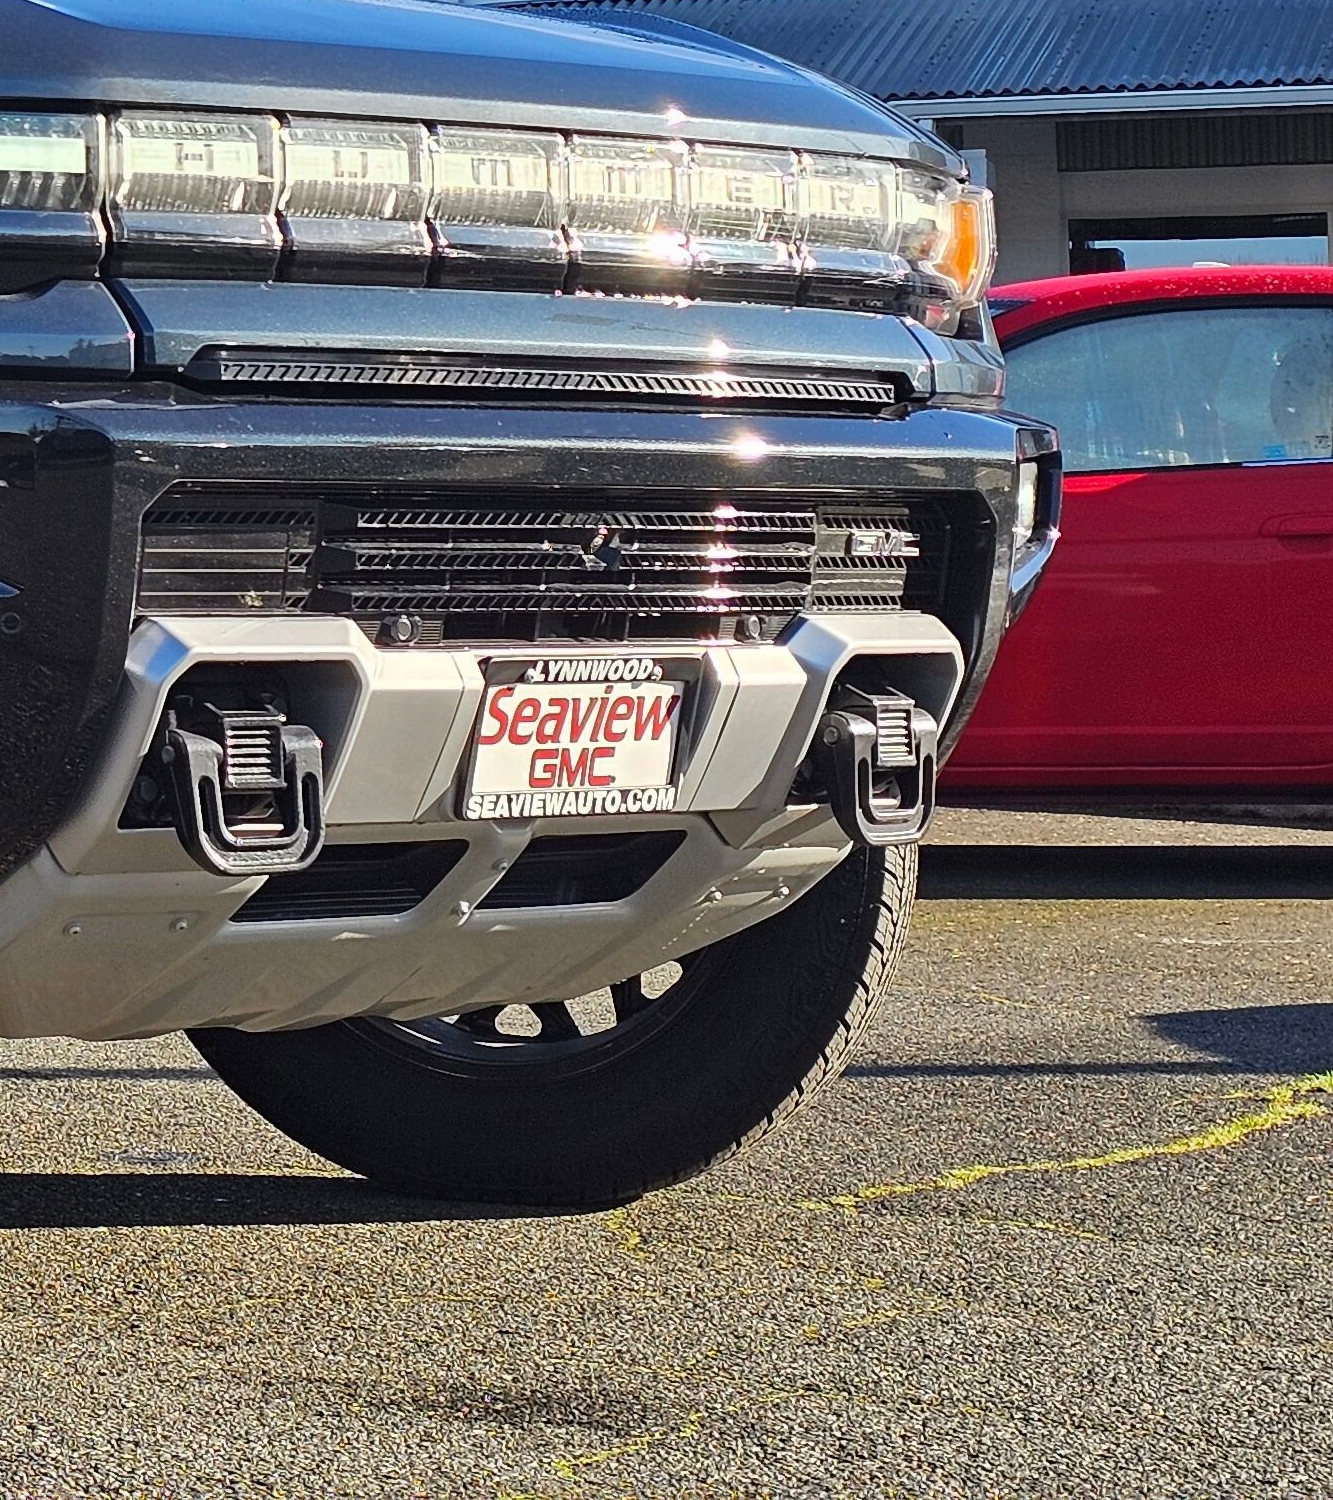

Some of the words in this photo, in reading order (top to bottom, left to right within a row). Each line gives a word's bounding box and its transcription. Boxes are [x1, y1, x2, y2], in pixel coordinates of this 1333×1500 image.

[533, 659, 654, 683] LYNNWOOD
[478, 685, 681, 745] Seaview
[528, 747, 616, 788] GMC
[466, 788, 676, 821] SEAVIEWAUTO.COM
